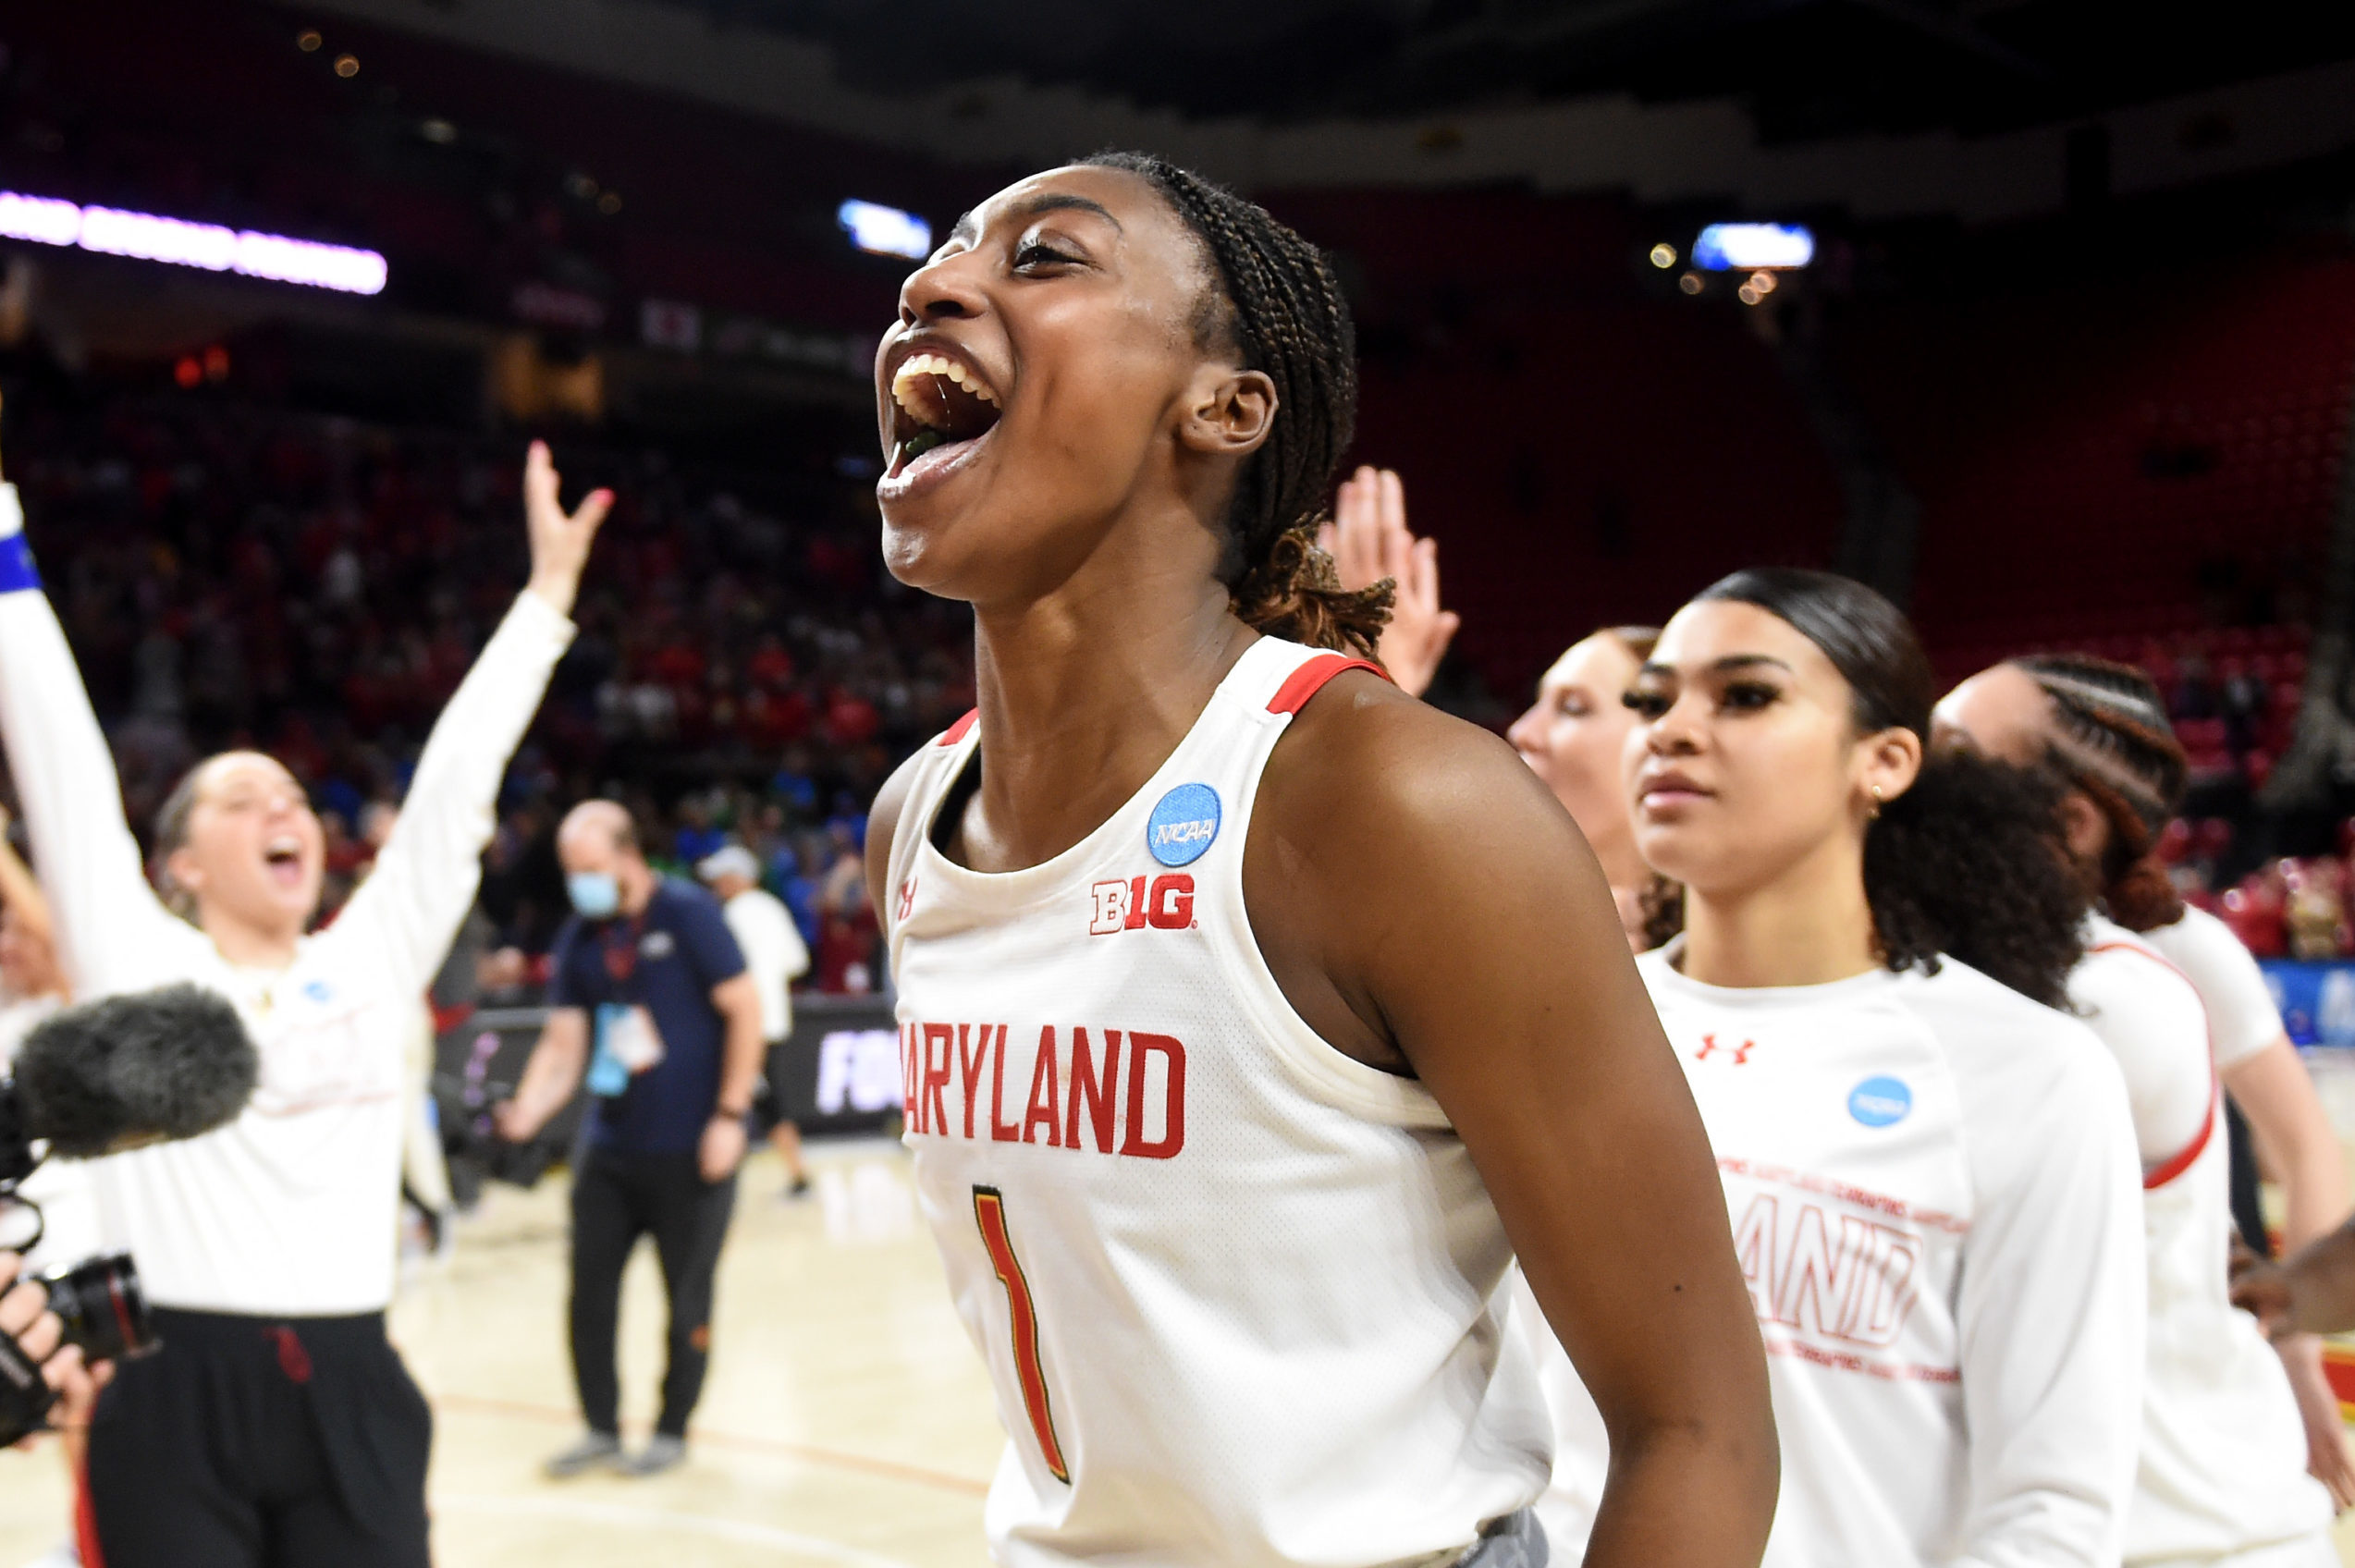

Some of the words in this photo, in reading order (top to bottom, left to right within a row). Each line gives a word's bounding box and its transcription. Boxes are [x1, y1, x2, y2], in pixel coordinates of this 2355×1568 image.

[1155, 819, 1214, 845] NCAA
[899, 1022, 1186, 1159] ARYLAND
[972, 1183, 1073, 1486] 1
